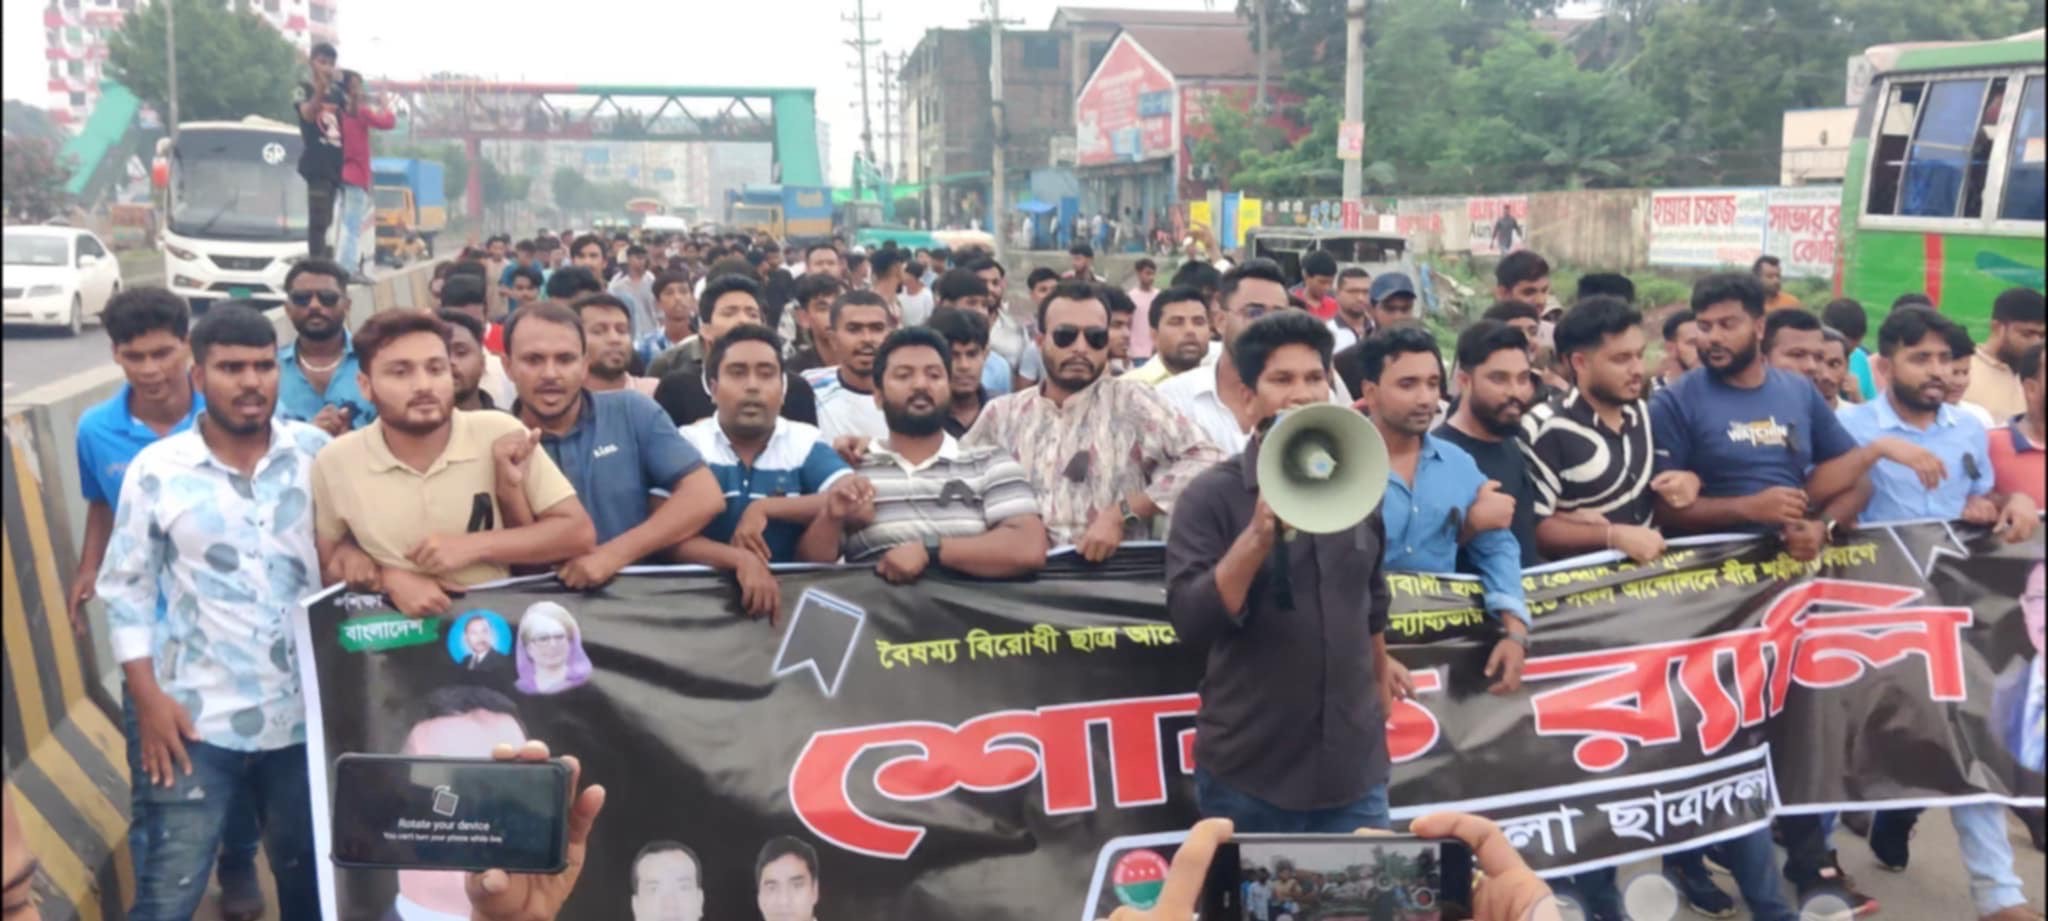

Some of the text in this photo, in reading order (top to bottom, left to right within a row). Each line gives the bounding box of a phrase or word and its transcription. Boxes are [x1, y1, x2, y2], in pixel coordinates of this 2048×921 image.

[1768, 205, 1826, 235] সাভার
[1622, 567, 1719, 600] আন্দোলনে
[1722, 558, 1757, 586] বীর
[344, 619, 424, 643] বাংলাদেশ
[876, 639, 961, 668] বৈষম্য
[966, 624, 1061, 659] বিরোধী
[1066, 625, 1118, 650] ছাত্র
[398, 818, 490, 832] Rotate your device
[1500, 767, 1768, 856] লা ছাত্রদল
